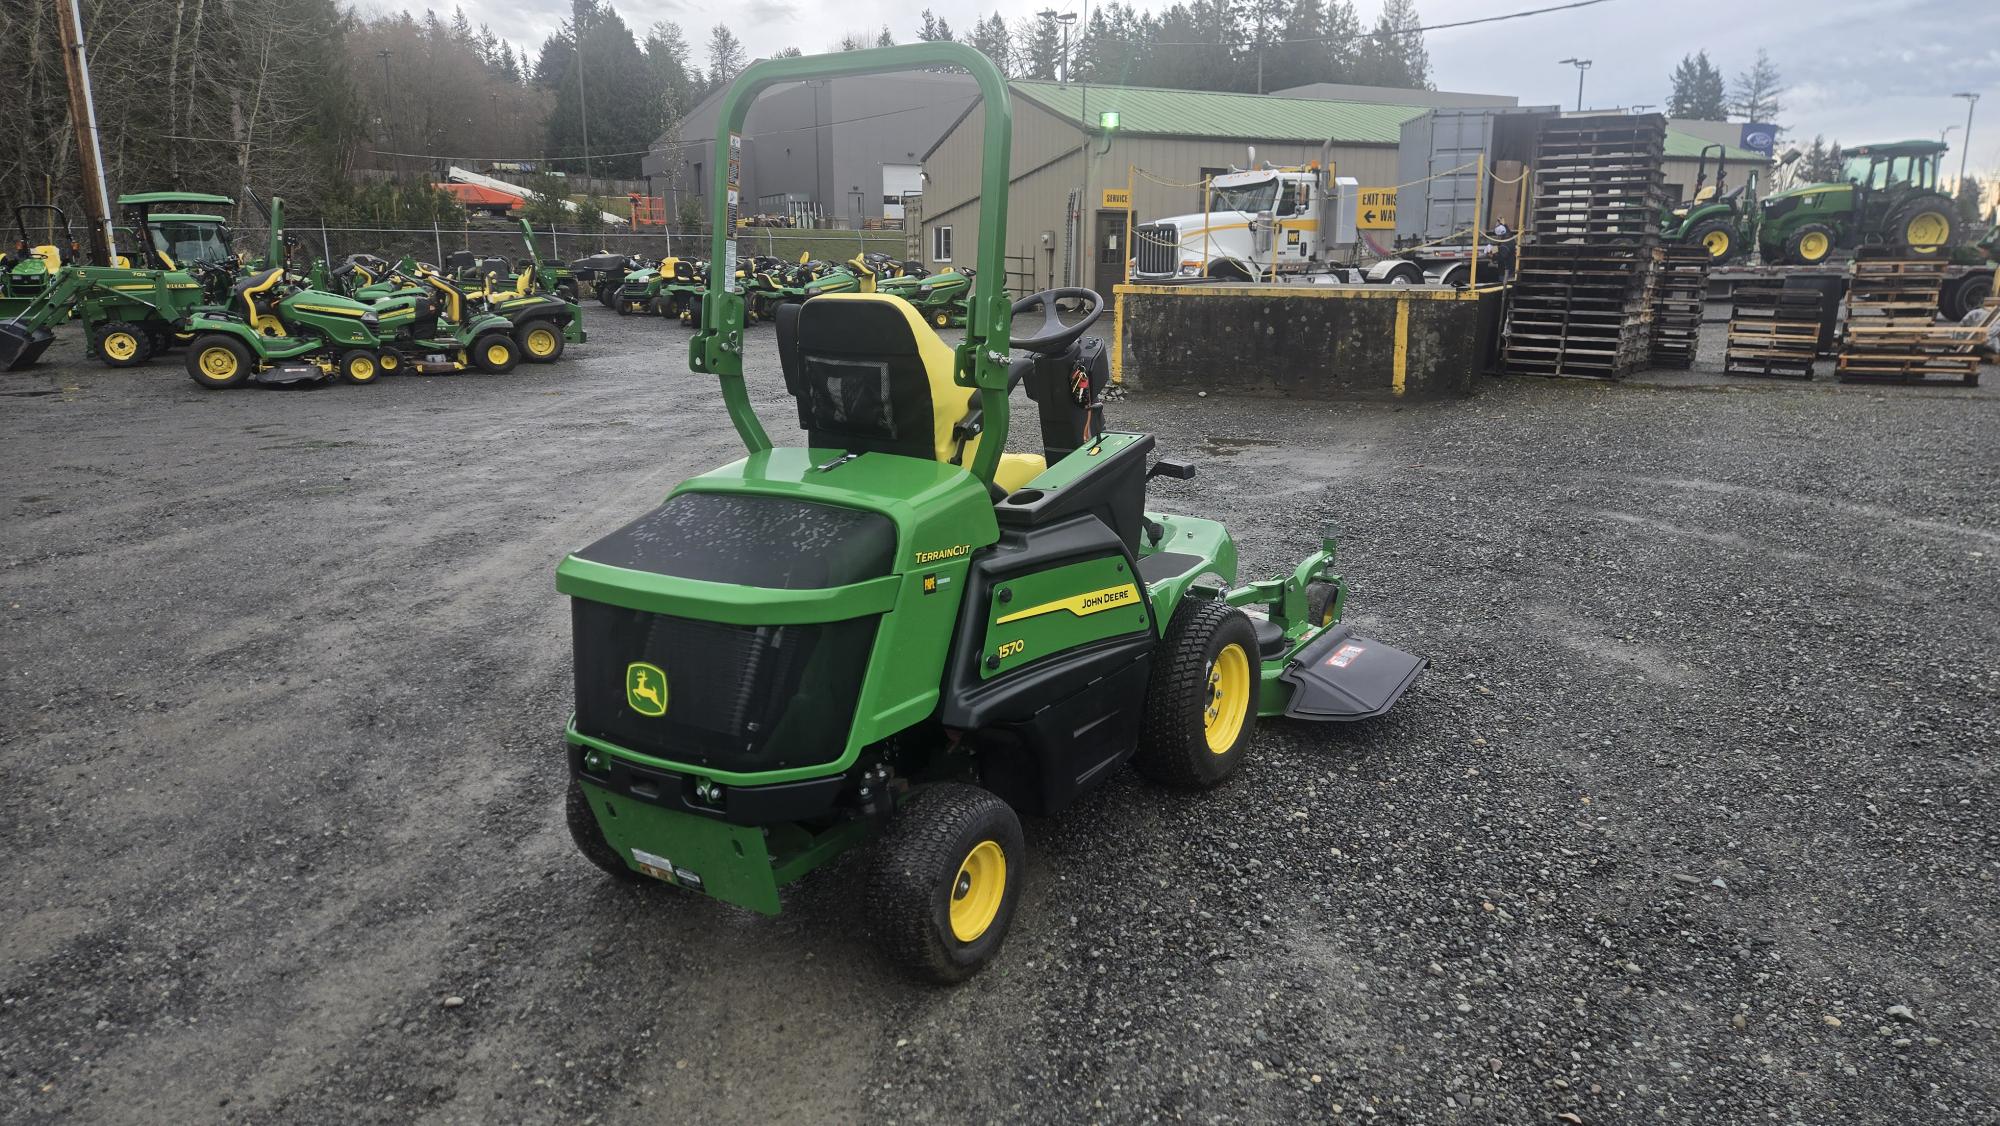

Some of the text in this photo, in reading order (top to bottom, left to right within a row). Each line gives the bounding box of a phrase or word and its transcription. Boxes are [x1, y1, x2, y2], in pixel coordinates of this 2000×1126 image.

[1106, 194, 1128, 203] SERVICE
[1362, 193, 1397, 206] EXIT THIS
[1081, 590, 1129, 609] JOHN DEERE
[998, 639, 1025, 659] 1570
